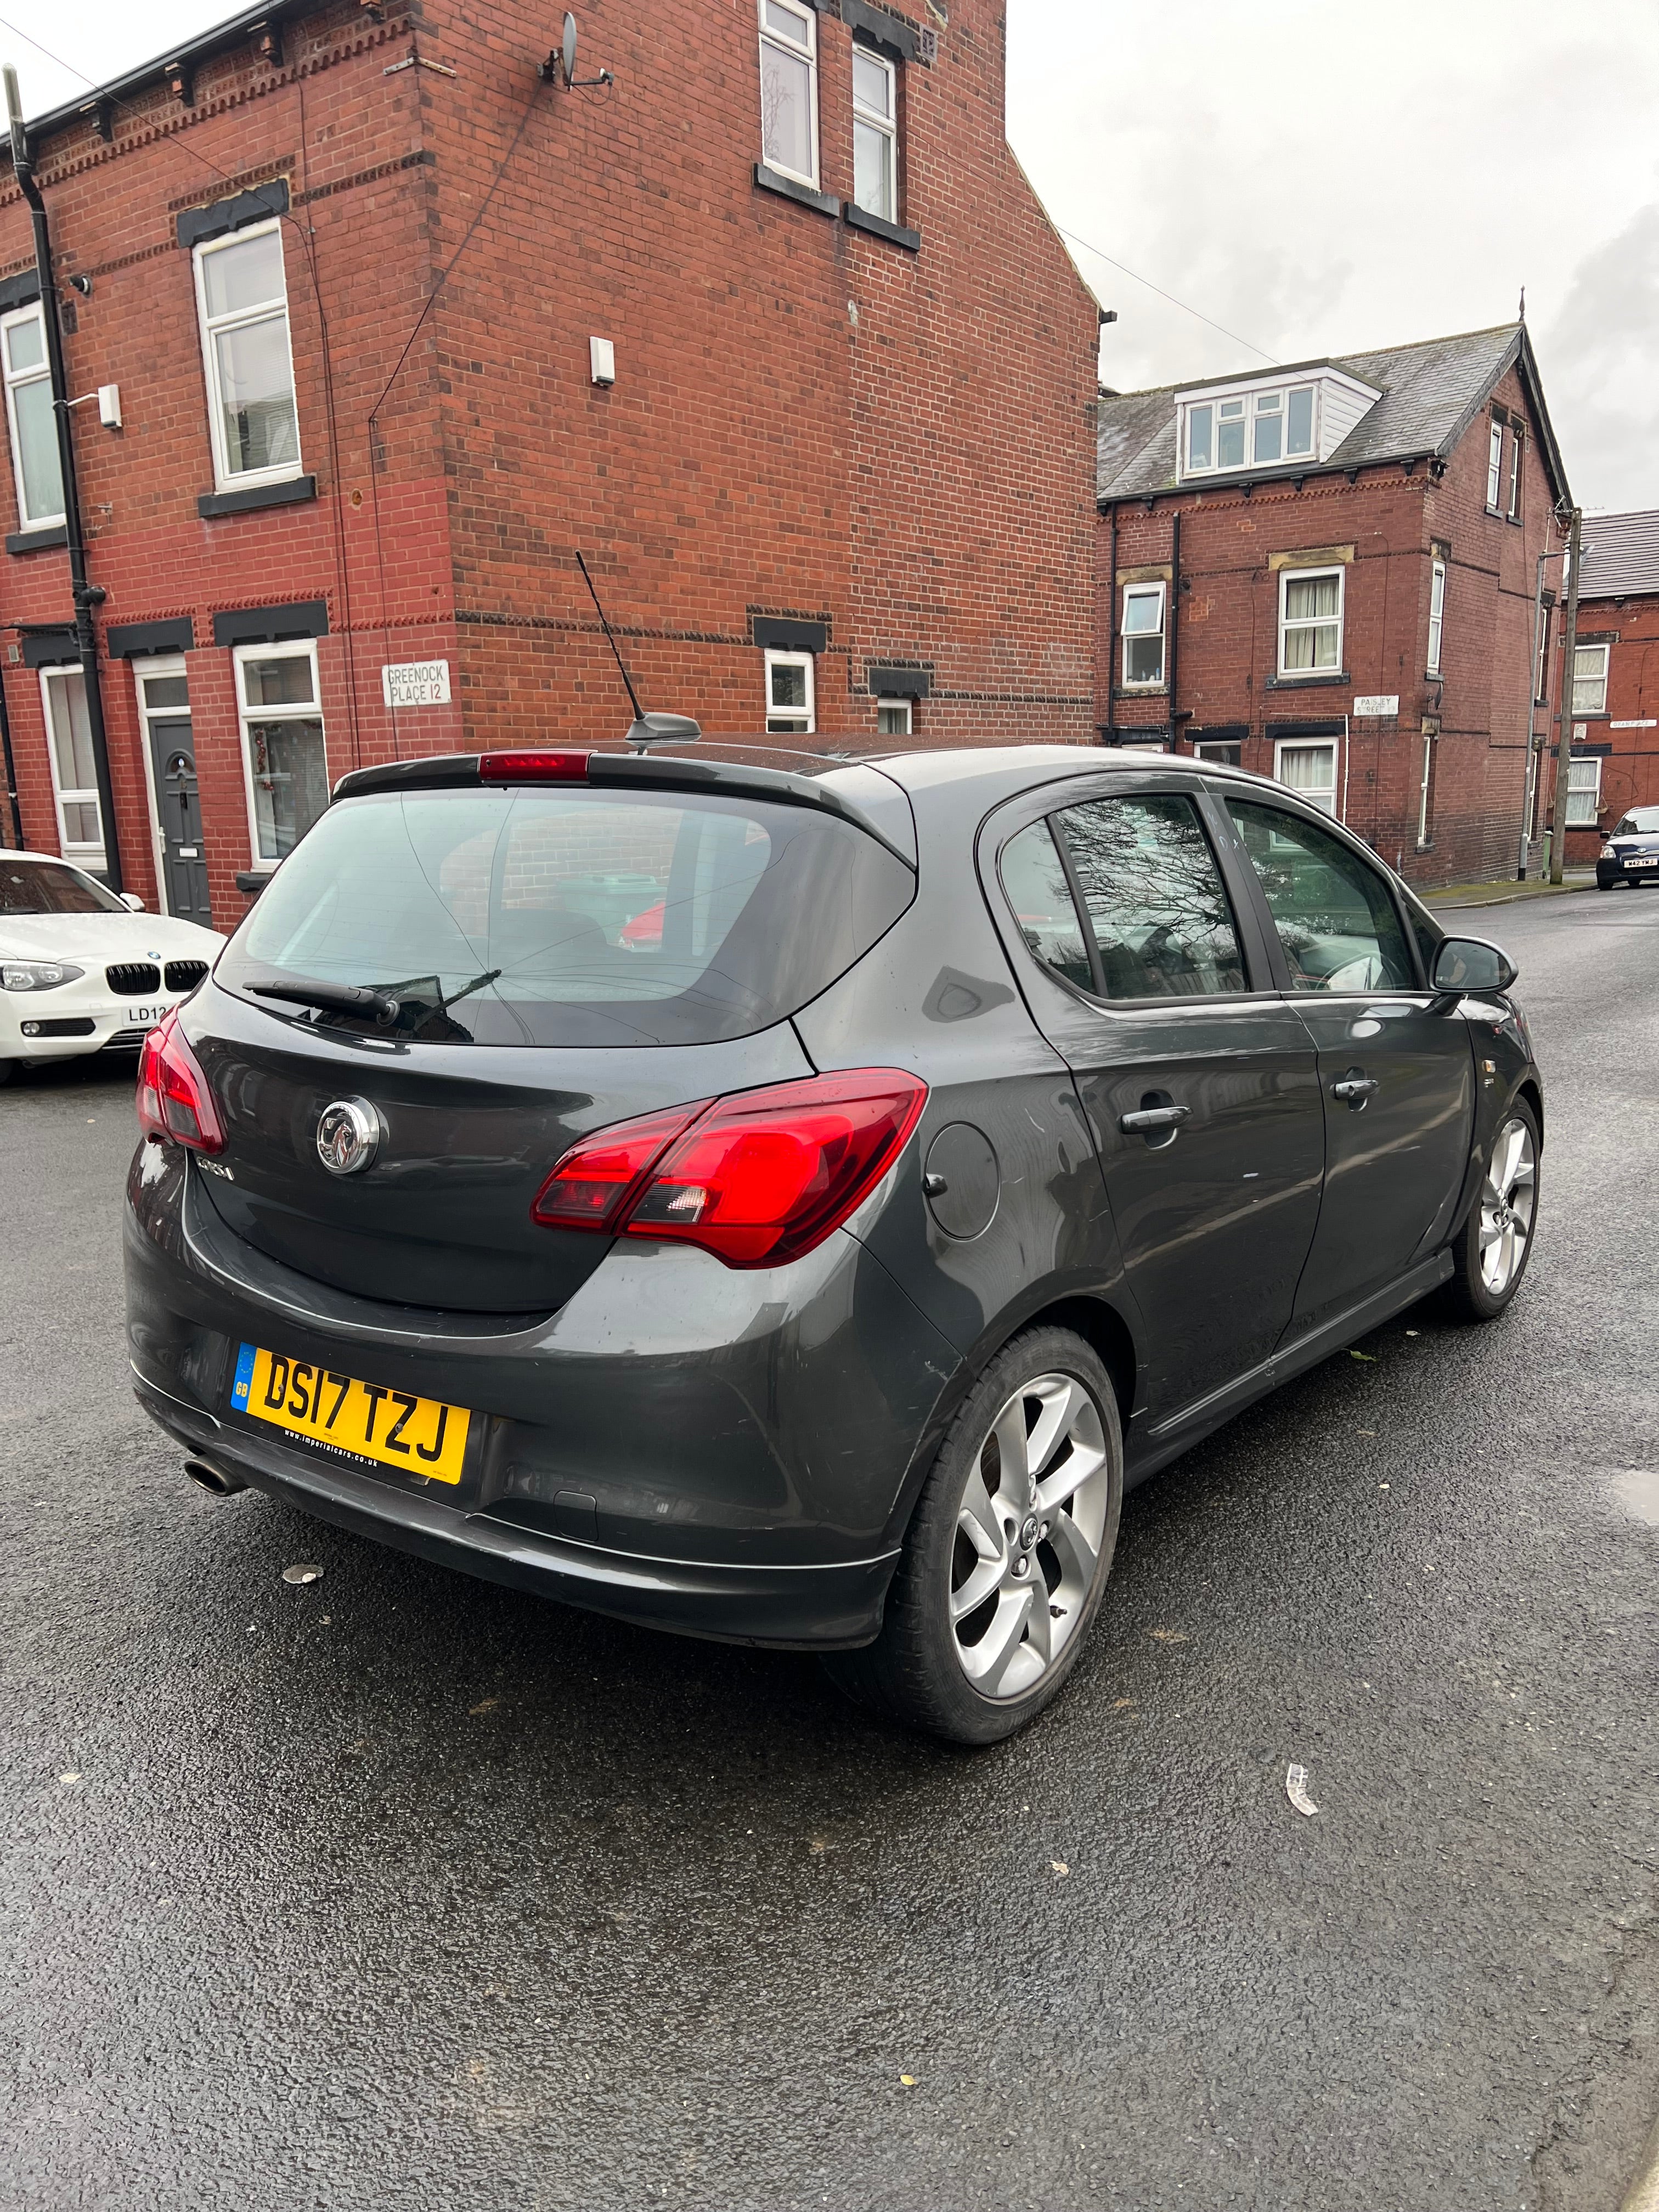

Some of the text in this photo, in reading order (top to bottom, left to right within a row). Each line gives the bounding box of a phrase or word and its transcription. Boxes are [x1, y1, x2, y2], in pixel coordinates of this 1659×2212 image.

[388, 665, 444, 685] GREENOCK
[392, 684, 441, 702] PLACE 12
[129, 1006, 167, 1021] LD12
[235, 1381, 248, 1397] GB
[264, 1353, 449, 1462] DS17 TZJ
[284, 1429, 378, 1468] www.imperialcars.co.uk
